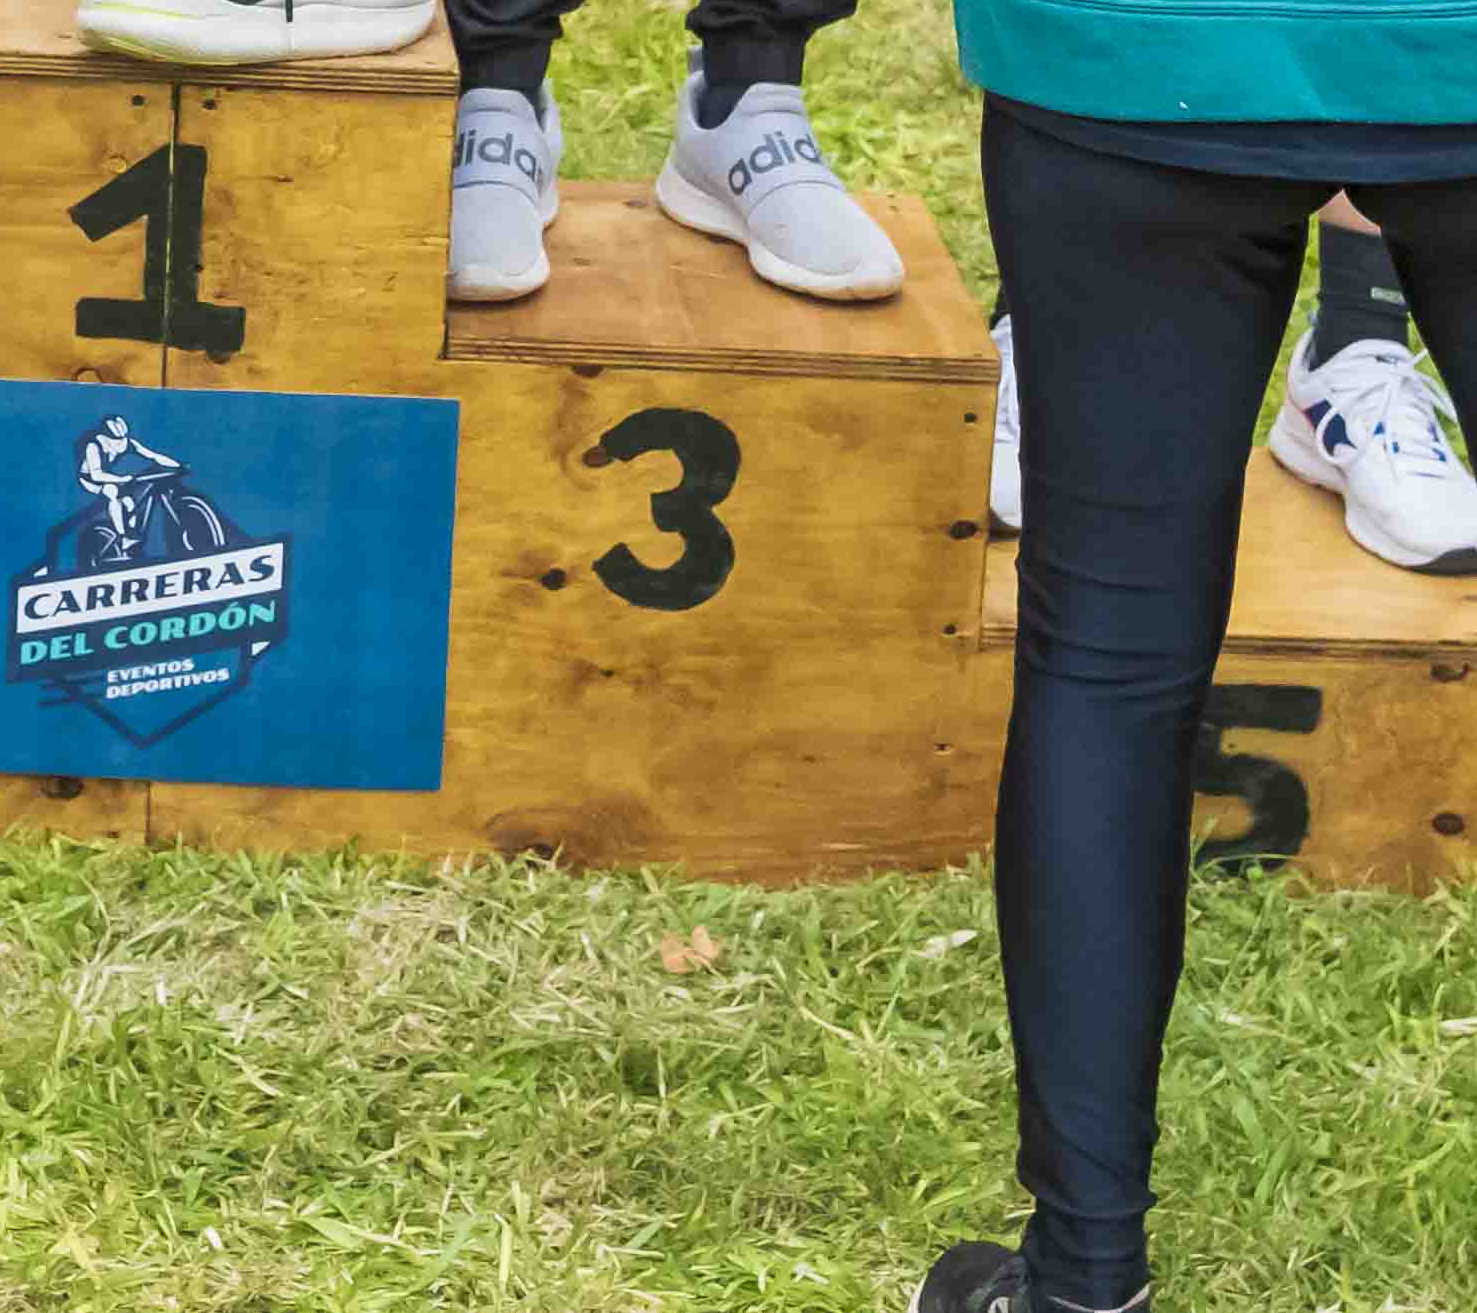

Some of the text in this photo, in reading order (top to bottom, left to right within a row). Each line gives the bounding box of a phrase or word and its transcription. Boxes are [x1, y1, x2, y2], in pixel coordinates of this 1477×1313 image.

[68, 142, 246, 356] 1
[582, 407, 741, 613] 3
[23, 554, 277, 622] CARRERAS
[20, 600, 277, 667] DEL CORDÓN
[105, 668, 231, 701] DEPORTIVOS
[106, 659, 196, 686] EVENTOS
[1191, 683, 1323, 876] 5
